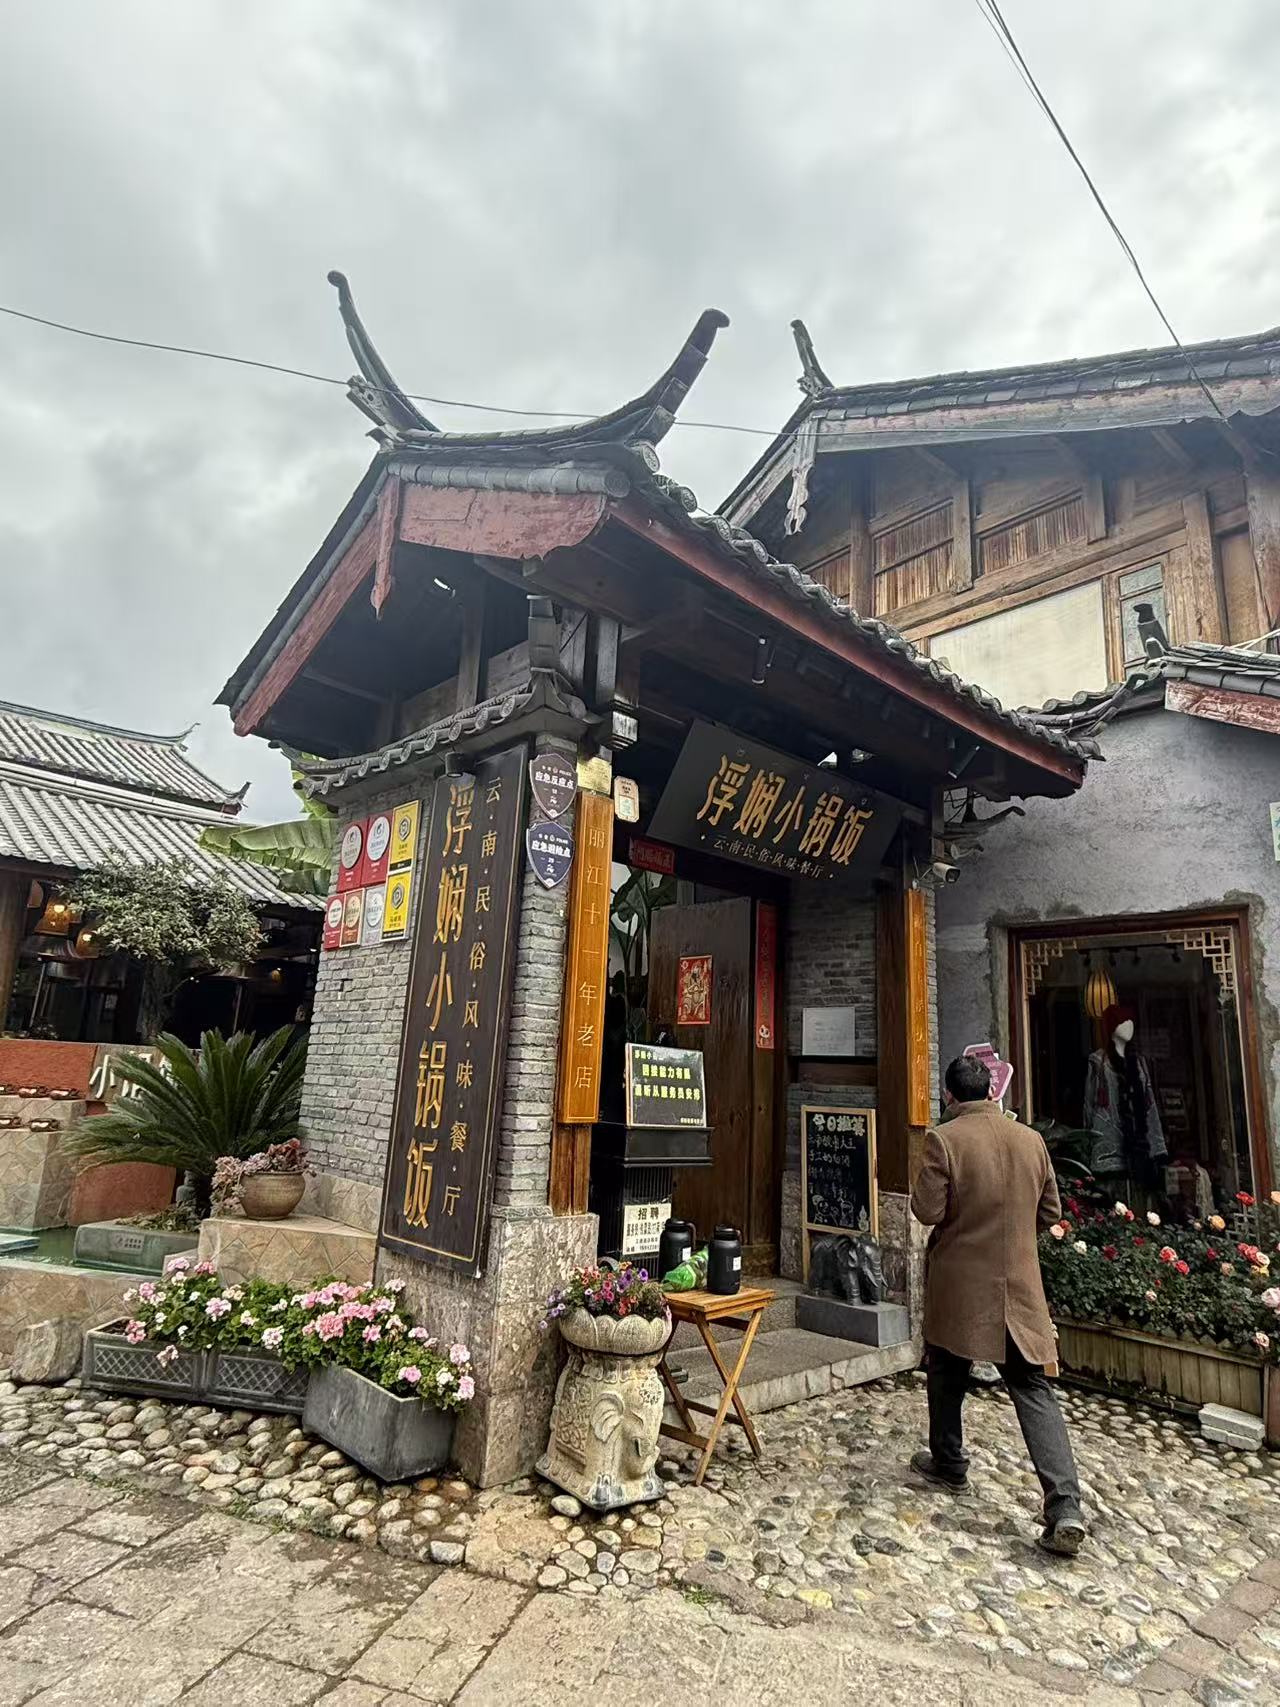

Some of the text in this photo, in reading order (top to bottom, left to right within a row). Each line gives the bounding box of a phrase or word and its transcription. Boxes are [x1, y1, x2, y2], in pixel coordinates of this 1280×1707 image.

[535, 771, 574, 790] 应急反应点
[696, 754, 874, 866] 浮娴小锅饭
[403, 782, 476, 1230] 浮娴小锅饭
[574, 827, 605, 1088] 丽江十一年老店
[638, 1207, 659, 1220] 招聘
